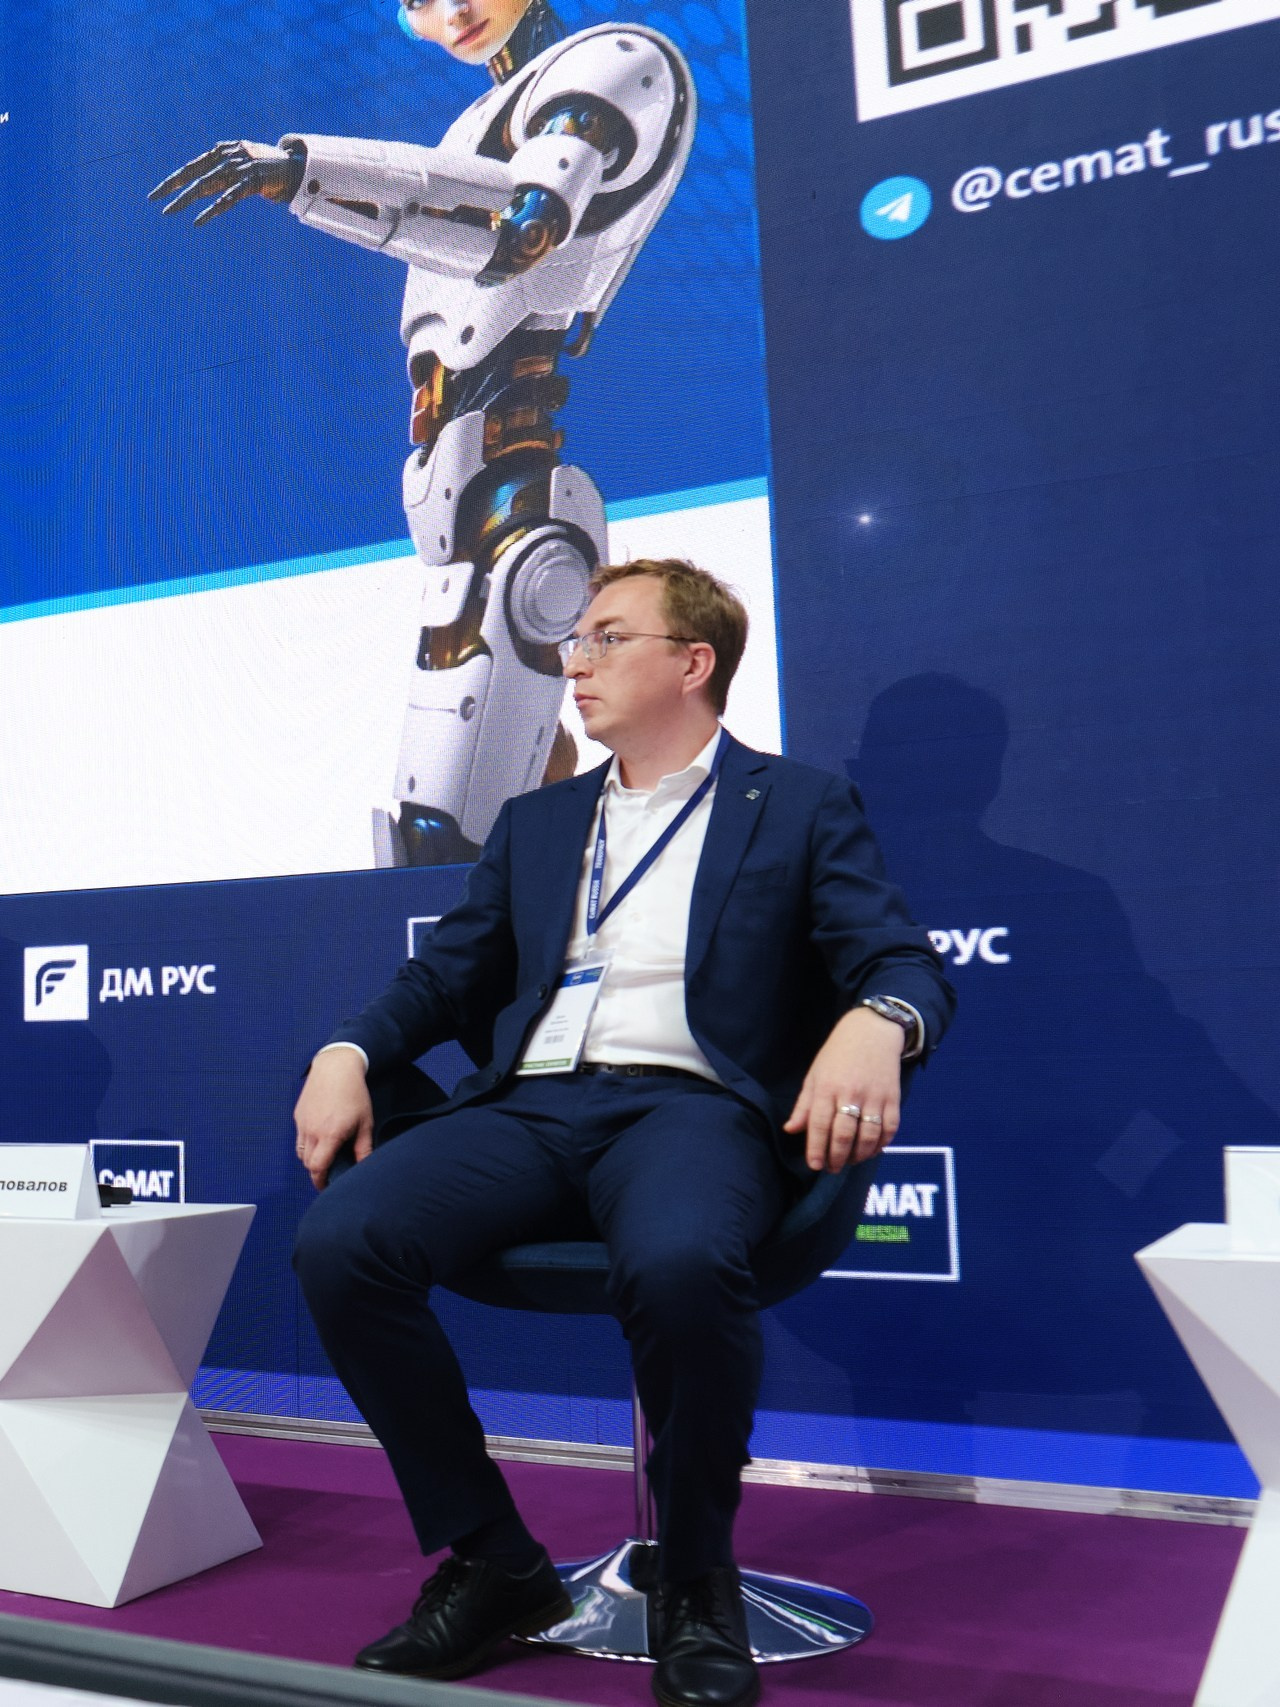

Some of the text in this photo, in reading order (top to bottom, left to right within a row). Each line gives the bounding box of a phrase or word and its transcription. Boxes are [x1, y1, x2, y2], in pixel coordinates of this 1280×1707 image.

[927, 927, 1012, 966] РУС
[99, 964, 216, 1003] ДМ РУС
[863, 1183, 940, 1217] MAT
